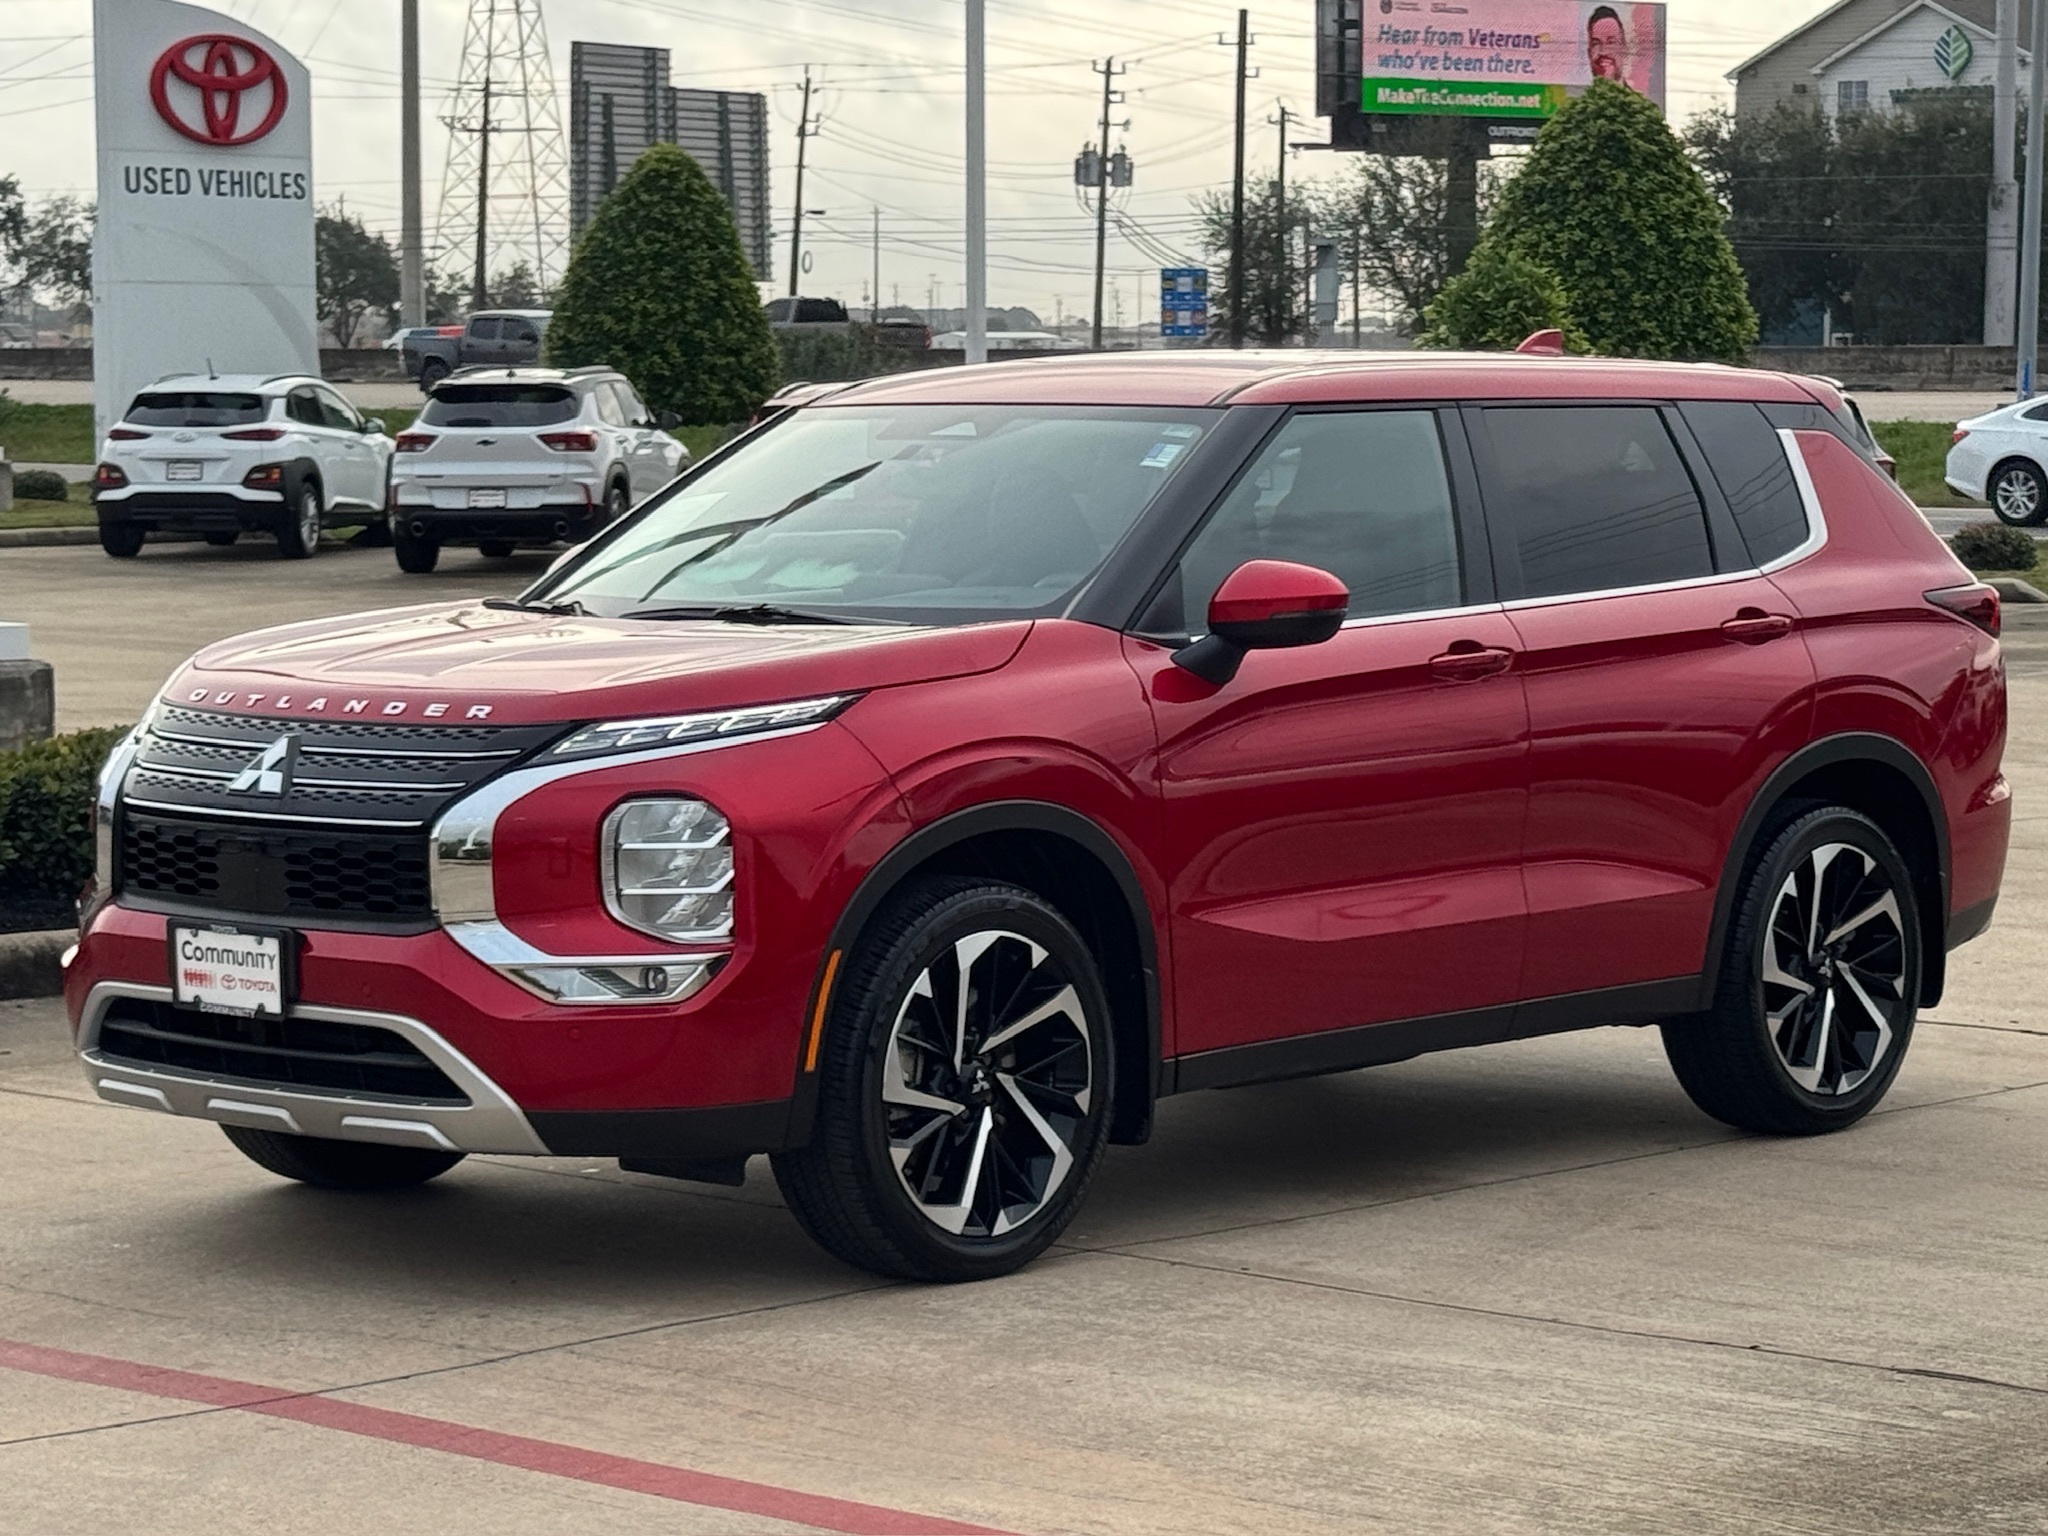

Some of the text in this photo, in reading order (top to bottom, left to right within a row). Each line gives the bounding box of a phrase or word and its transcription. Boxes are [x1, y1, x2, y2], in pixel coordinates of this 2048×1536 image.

[1377, 23, 1541, 49] Hear from Veterans
[1377, 49, 1536, 74] who've been there.
[124, 166, 306, 200] USED VEHICLES
[188, 688, 493, 720] OUTLANDER
[238, 978, 277, 993] TOYOTA
